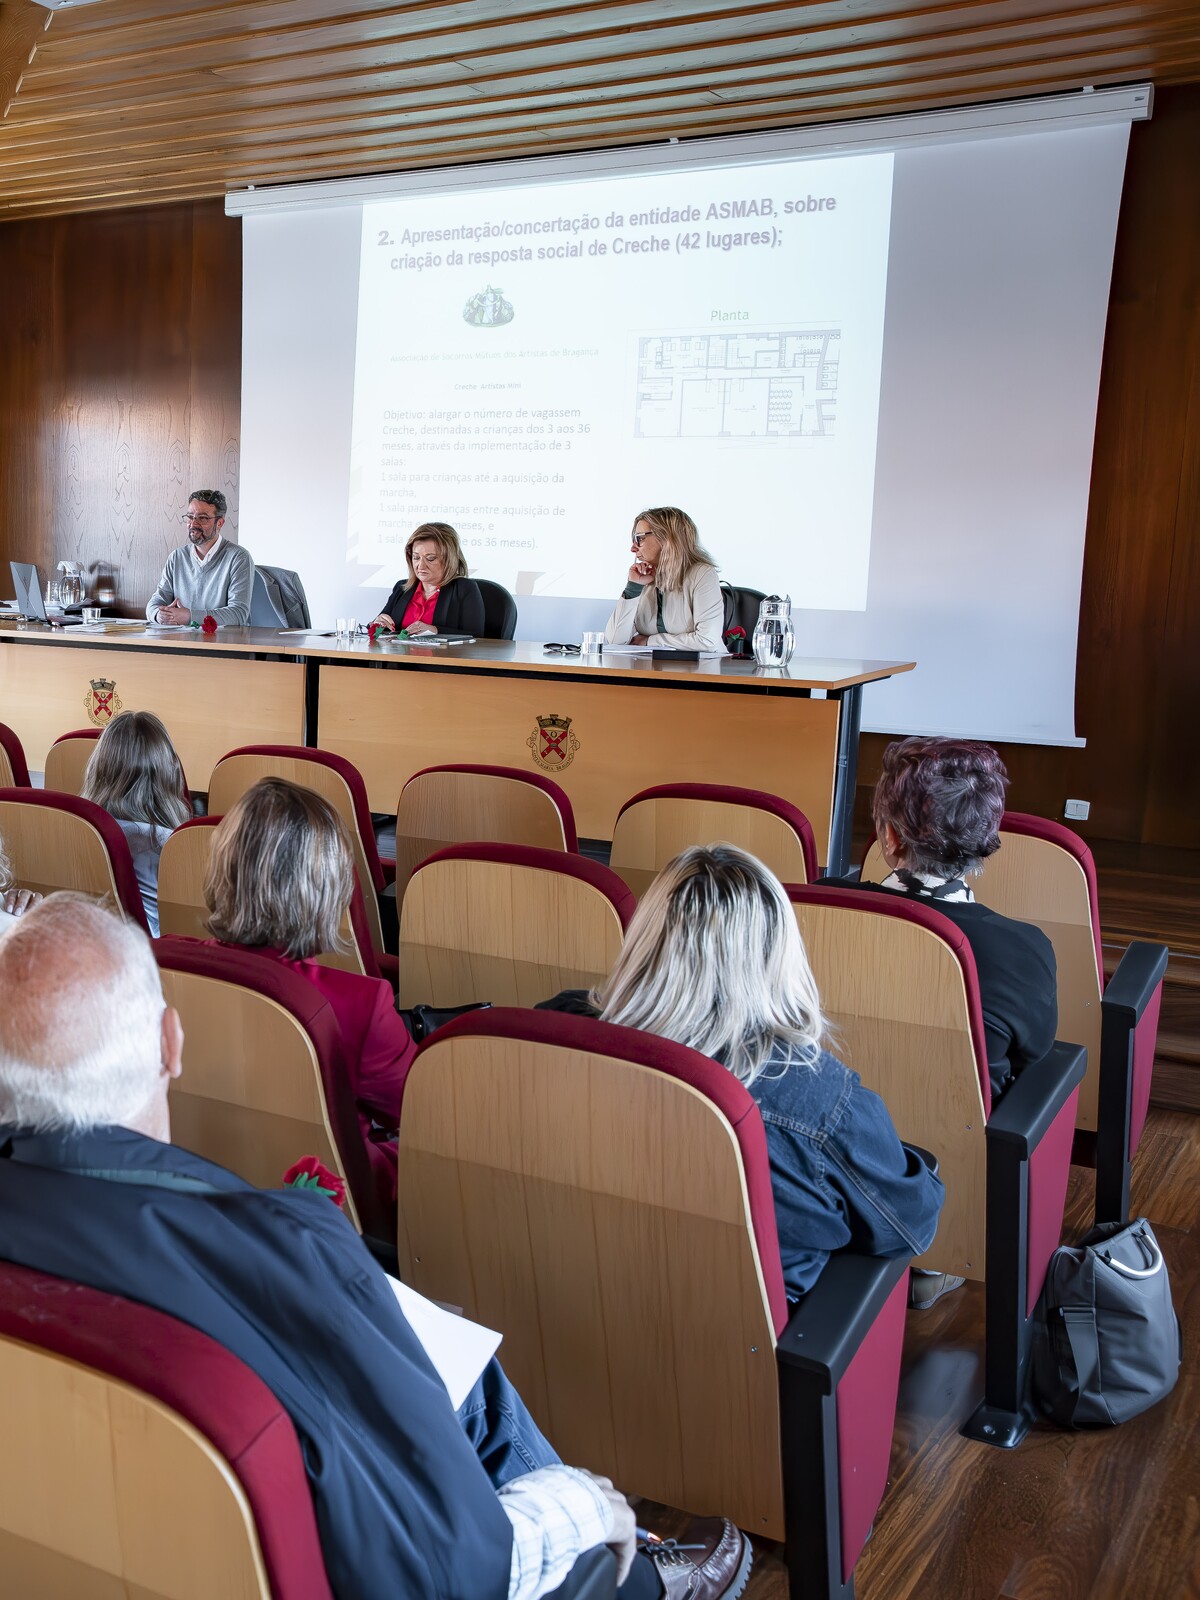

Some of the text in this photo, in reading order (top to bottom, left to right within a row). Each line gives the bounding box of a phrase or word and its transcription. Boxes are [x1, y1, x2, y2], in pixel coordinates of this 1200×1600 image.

[378, 194, 836, 246] 2. Apresentação/concertação da entidade ASMAB, sobre
[390, 227, 783, 271] criação da resposta social de Creche (42 lugares);
[711, 310, 749, 321] Planta
[384, 409, 581, 421] Objetivo: alargar o número de vagassem
[383, 426, 417, 436] Creche,
[420, 425, 472, 434] destinadas
[483, 424, 523, 437] crianças
[526, 424, 544, 433] dos
[548, 424, 553, 433] 3
[577, 424, 590, 433] 36
[382, 441, 571, 452] meses, através da implementação de 3
[381, 457, 406, 466] salas:
[381, 473, 386, 481] 1
[388, 473, 407, 481] sala
[409, 474, 430, 483] para
[433, 473, 471, 484] crianças
[475, 473, 490, 482] até
[502, 473, 549, 485] aquisição
[552, 473, 564, 483] da
[380, 488, 417, 498] marcha,
[379, 504, 565, 517] 1 sala para crianças entre aquisição de
[379, 519, 412, 528] marcha
[384, 534, 403, 544] sala
[485, 538, 497, 546] 36
[500, 538, 538, 549] meses).
